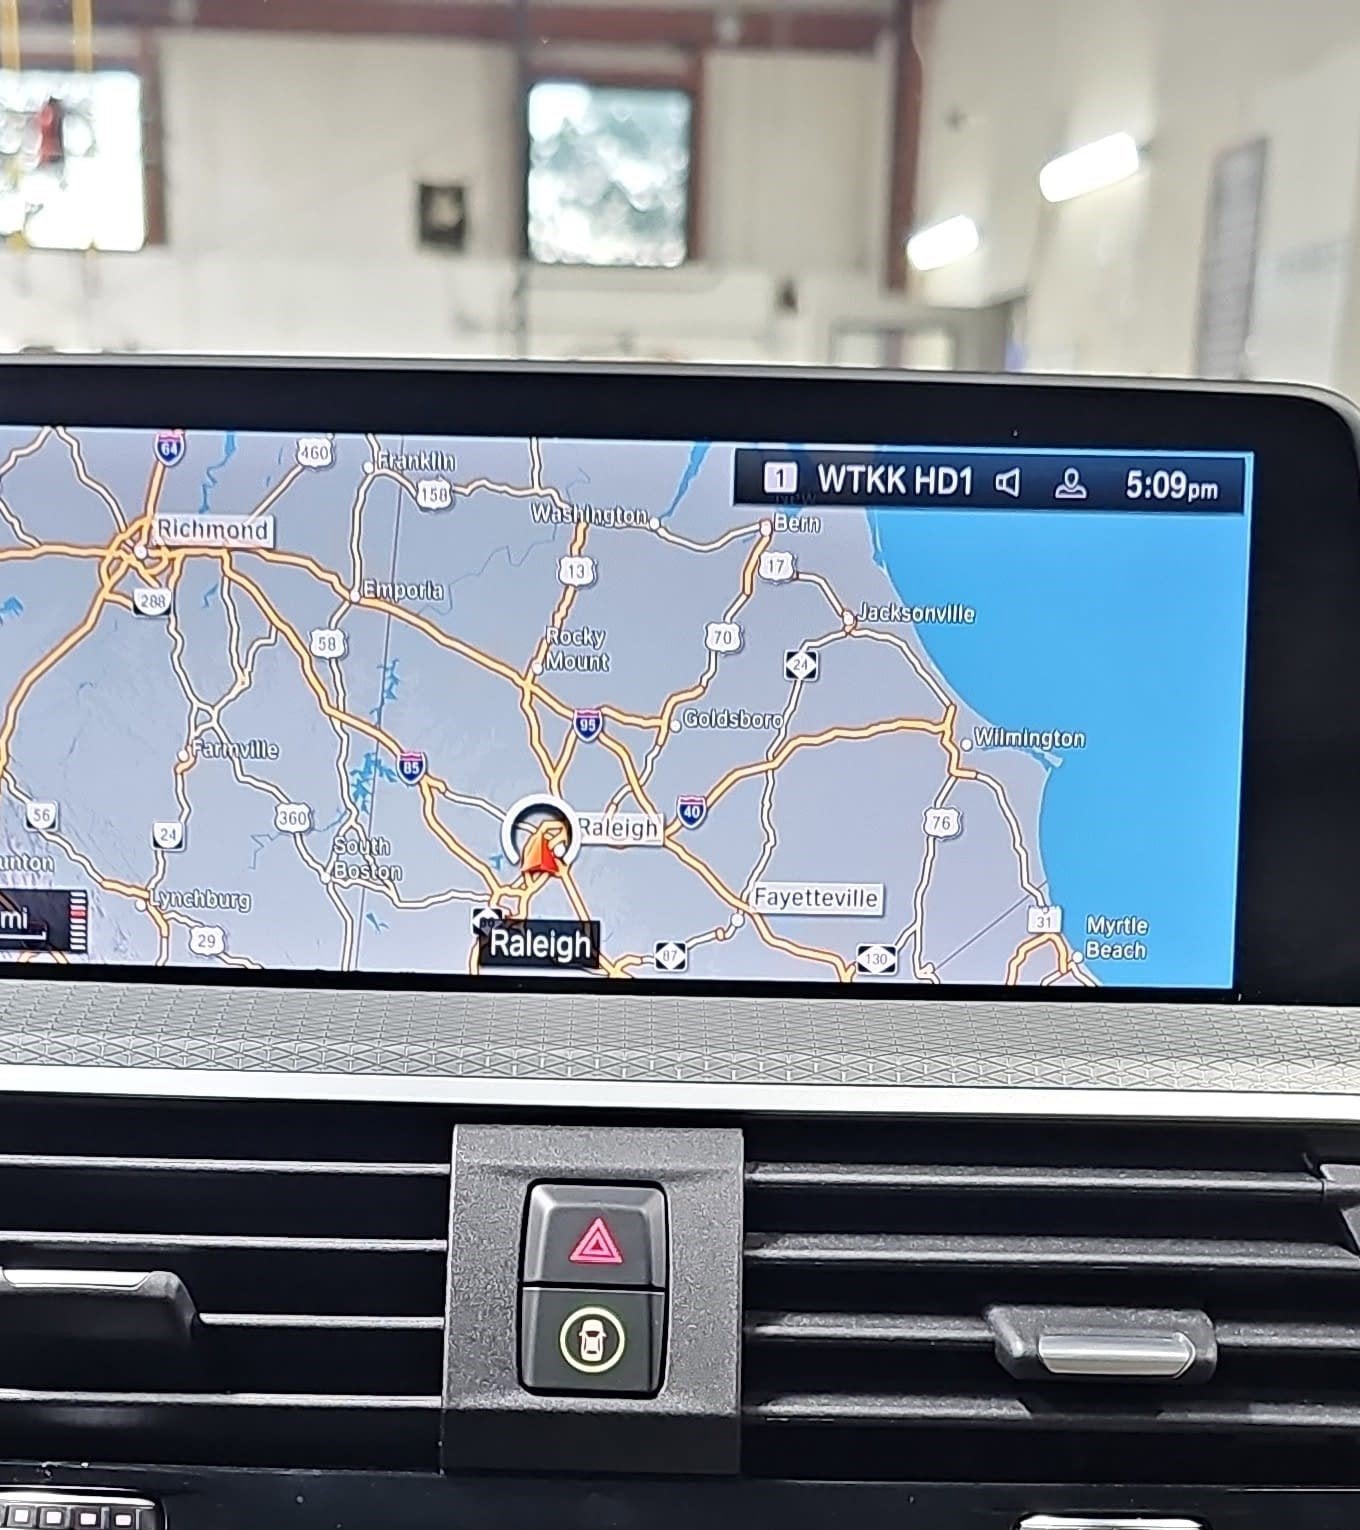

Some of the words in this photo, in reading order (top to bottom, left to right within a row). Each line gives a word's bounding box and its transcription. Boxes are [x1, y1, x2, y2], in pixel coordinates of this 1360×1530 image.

[161, 440, 178, 456] 64
[301, 445, 328, 461] 460
[377, 451, 455, 472] Franklin
[775, 469, 784, 488] 1
[817, 463, 906, 494] WTKK
[915, 465, 973, 496] HD1
[1125, 469, 1219, 503] 5:09pm
[421, 486, 449, 502] 158
[531, 505, 648, 528] Washington
[774, 512, 821, 533] Bern
[158, 518, 269, 542] Richmond
[569, 563, 585, 579] 13
[767, 559, 785, 573] 17
[363, 580, 444, 602] Emporia
[141, 594, 166, 610] 288
[856, 602, 976, 624] Jacksonville
[318, 635, 337, 652] 58
[545, 628, 606, 650] Rocky
[714, 630, 732, 644] 70
[545, 652, 610, 672] Mount
[792, 658, 809, 670] 24
[579, 719, 596, 732] 95
[682, 709, 785, 730] Goldsboro
[974, 727, 1086, 749] Wilmington
[191, 738, 279, 760] Farmville
[403, 761, 419, 775] 85
[32, 808, 51, 821] 56
[279, 812, 306, 826] 360
[683, 806, 700, 819] 40
[578, 817, 658, 840] Raleigh
[933, 815, 950, 831] 76
[160, 828, 177, 842] 24
[333, 837, 391, 856] South
[333, 862, 403, 881] Boston
[149, 889, 252, 913] Lynchburg
[754, 886, 878, 911] Fayetteville
[0, 907, 29, 930] mi
[1036, 916, 1052, 930] 31
[1086, 915, 1149, 939] Myrtle
[197, 934, 216, 949] 29
[490, 929, 591, 959] Raleigh
[1085, 941, 1147, 960] Beach
[865, 952, 888, 966] 130
